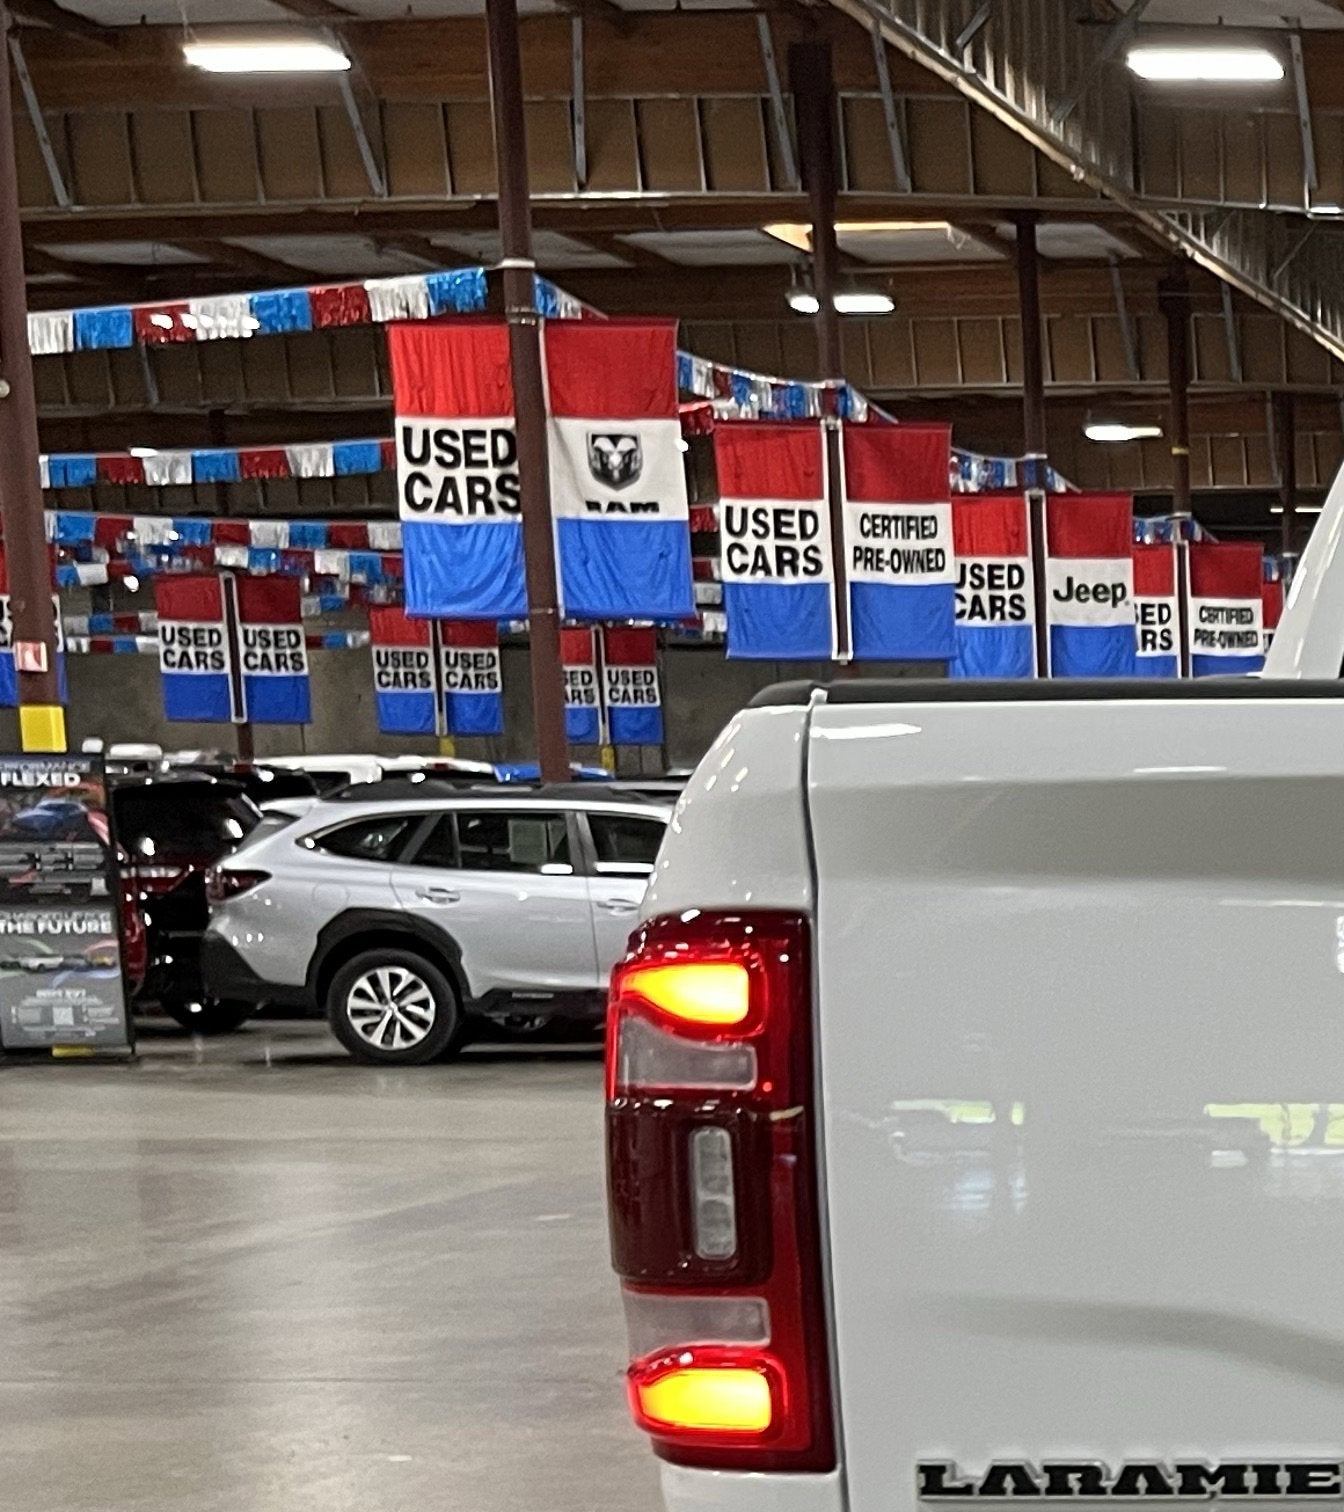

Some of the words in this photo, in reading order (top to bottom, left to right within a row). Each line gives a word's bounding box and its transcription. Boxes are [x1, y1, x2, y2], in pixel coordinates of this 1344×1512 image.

[402, 426, 517, 470] USED
[404, 471, 521, 516] CARS
[585, 501, 660, 513] RAM
[725, 505, 819, 541] USED
[859, 513, 938, 540] CERTIFIED
[726, 542, 823, 577] CARS
[853, 546, 945, 574] PRE-OWNED
[1053, 576, 1127, 608] Jeep
[1134, 603, 1172, 625] ED
[1199, 605, 1254, 625] CERTIFIED
[161, 625, 222, 648] USED
[243, 629, 301, 649] USED
[1137, 628, 1173, 652] RS
[1194, 628, 1259, 649] PRE-OWNED
[163, 649, 225, 671] CARS
[244, 651, 304, 672] CARS
[376, 650, 429, 669] USED
[445, 651, 496, 670] USED
[377, 671, 431, 689] CARS
[445, 671, 498, 690] CARS
[564, 670, 593, 686] ED
[607, 669, 655, 686] USED
[609, 687, 657, 704] CARS
[37, 919, 112, 934] FUTURE
[917, 1460, 1344, 1499] LARAMIE
